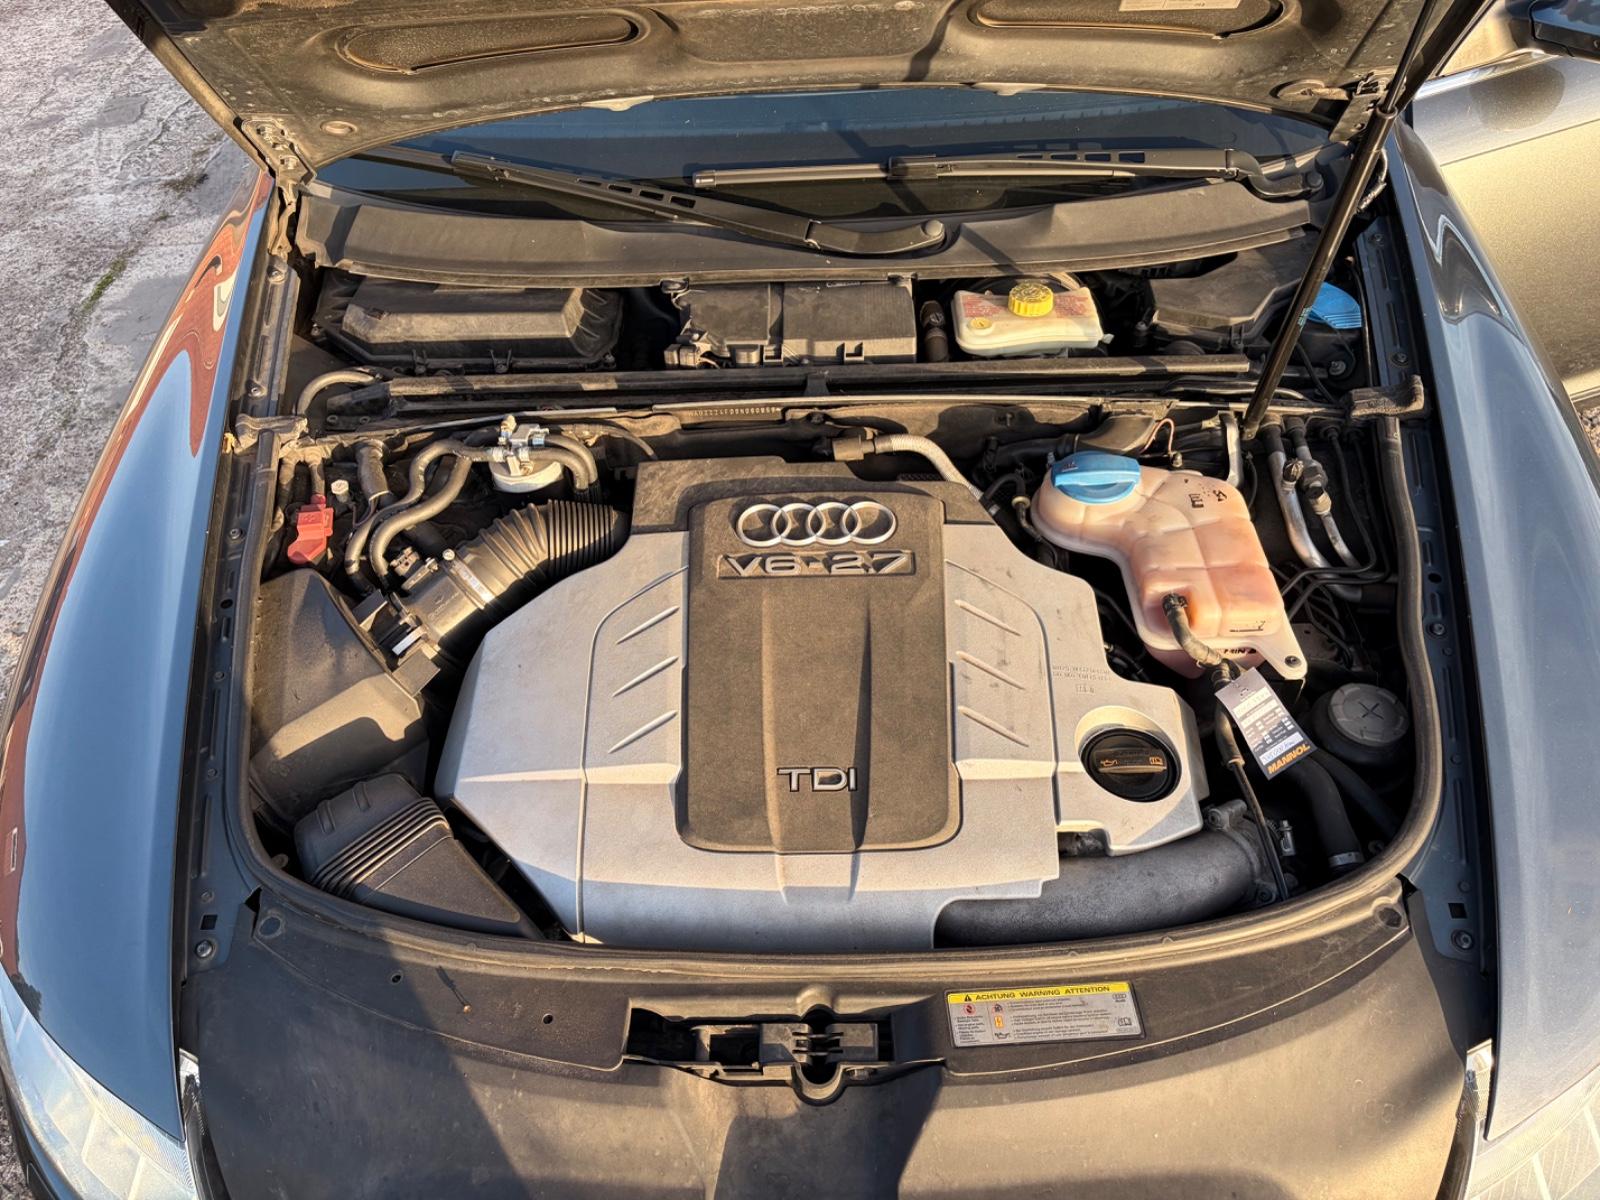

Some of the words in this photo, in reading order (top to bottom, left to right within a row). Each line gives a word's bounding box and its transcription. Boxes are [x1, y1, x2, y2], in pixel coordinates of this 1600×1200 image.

[1267, 743, 1311, 774] MANNOL
[777, 766, 858, 792] TDI
[975, 992, 1016, 1001] ACHTUNG
[1020, 989, 1061, 998] WARNING
[1064, 986, 1110, 994] ATTENTION
